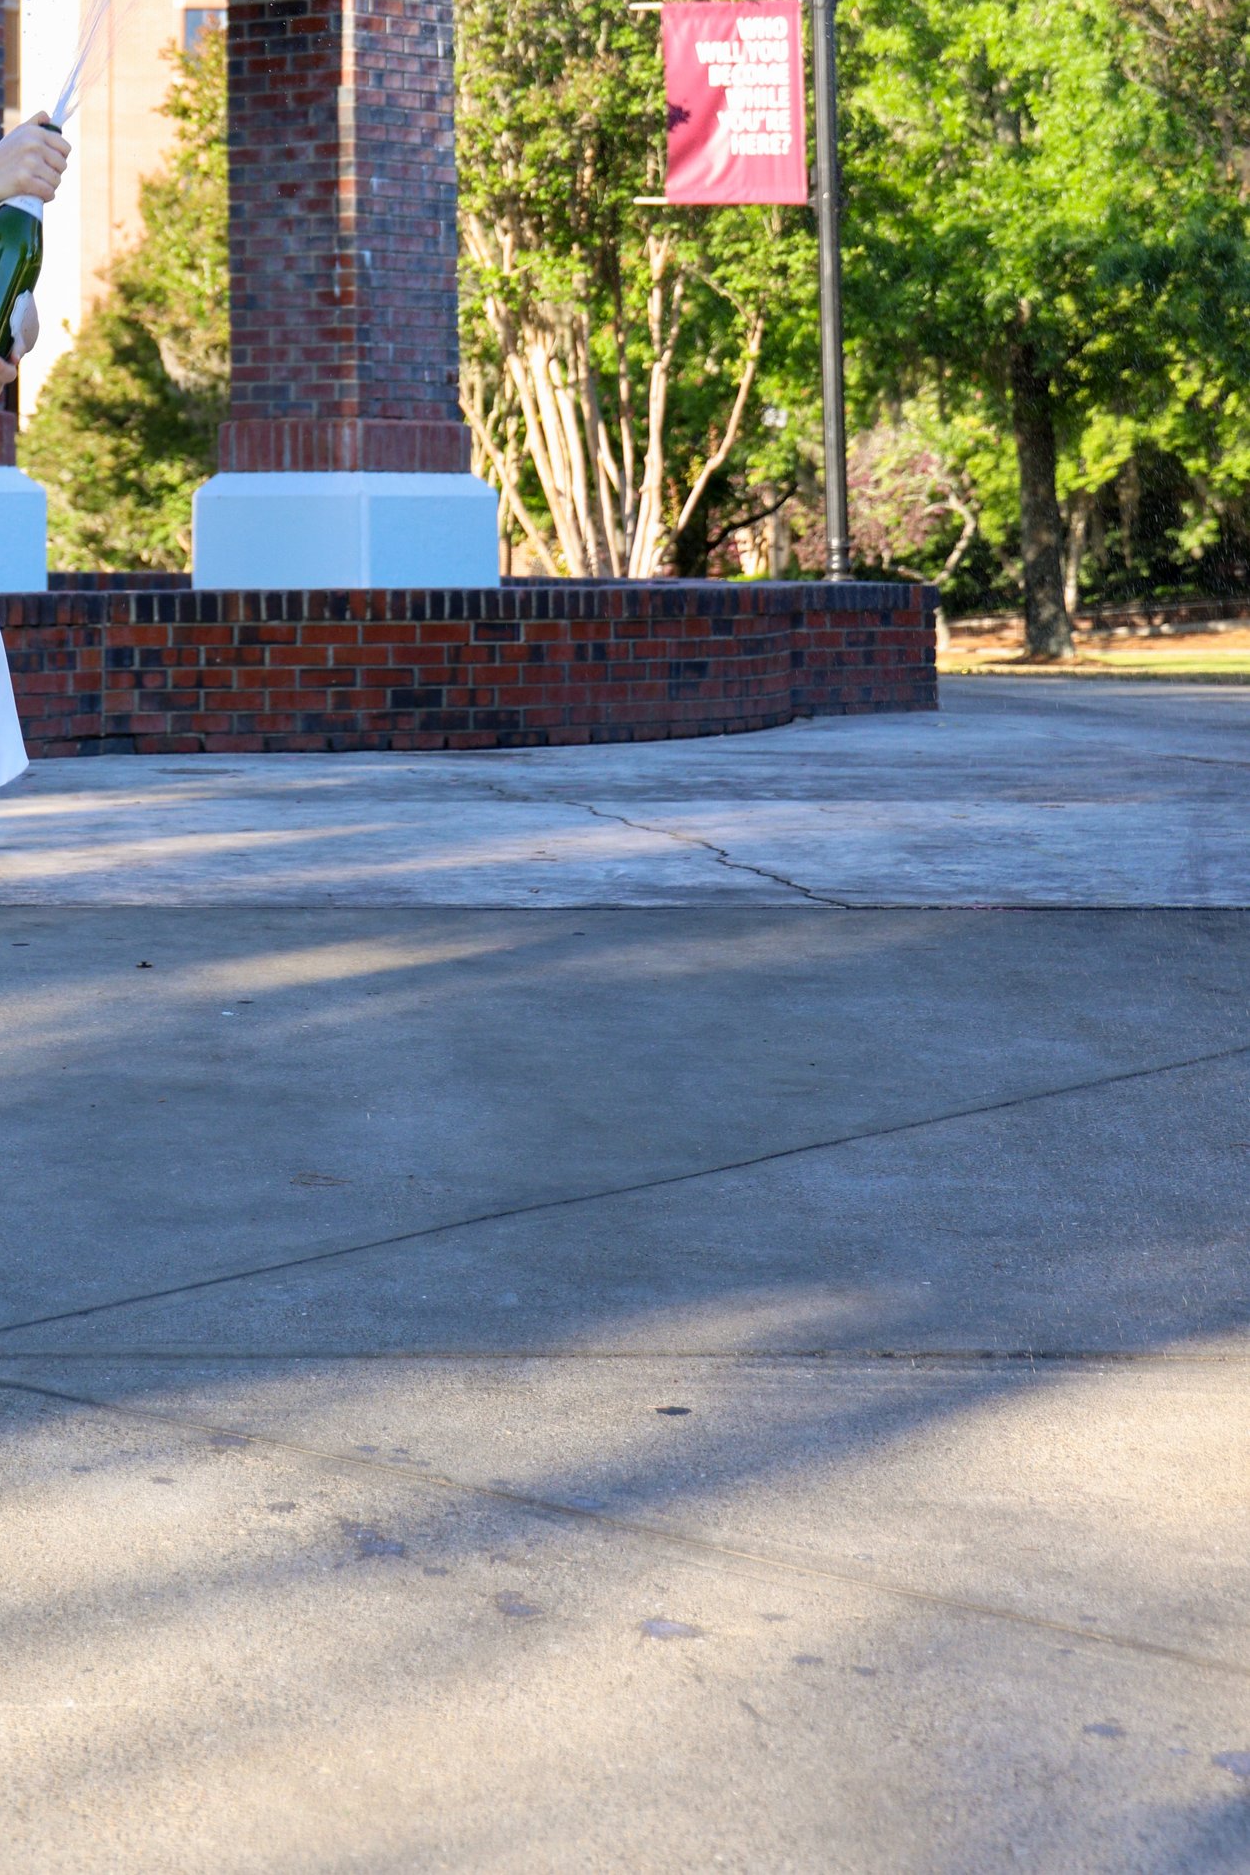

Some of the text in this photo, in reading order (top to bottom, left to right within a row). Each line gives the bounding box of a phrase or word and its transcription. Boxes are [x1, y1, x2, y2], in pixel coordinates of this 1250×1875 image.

[736, 16, 788, 40] WHO
[695, 39, 789, 64] WILL YOU
[708, 63, 790, 87] BECOME
[725, 86, 790, 110] WHILE
[717, 109, 790, 132] YOU'RE
[730, 132, 792, 155] HERE?
